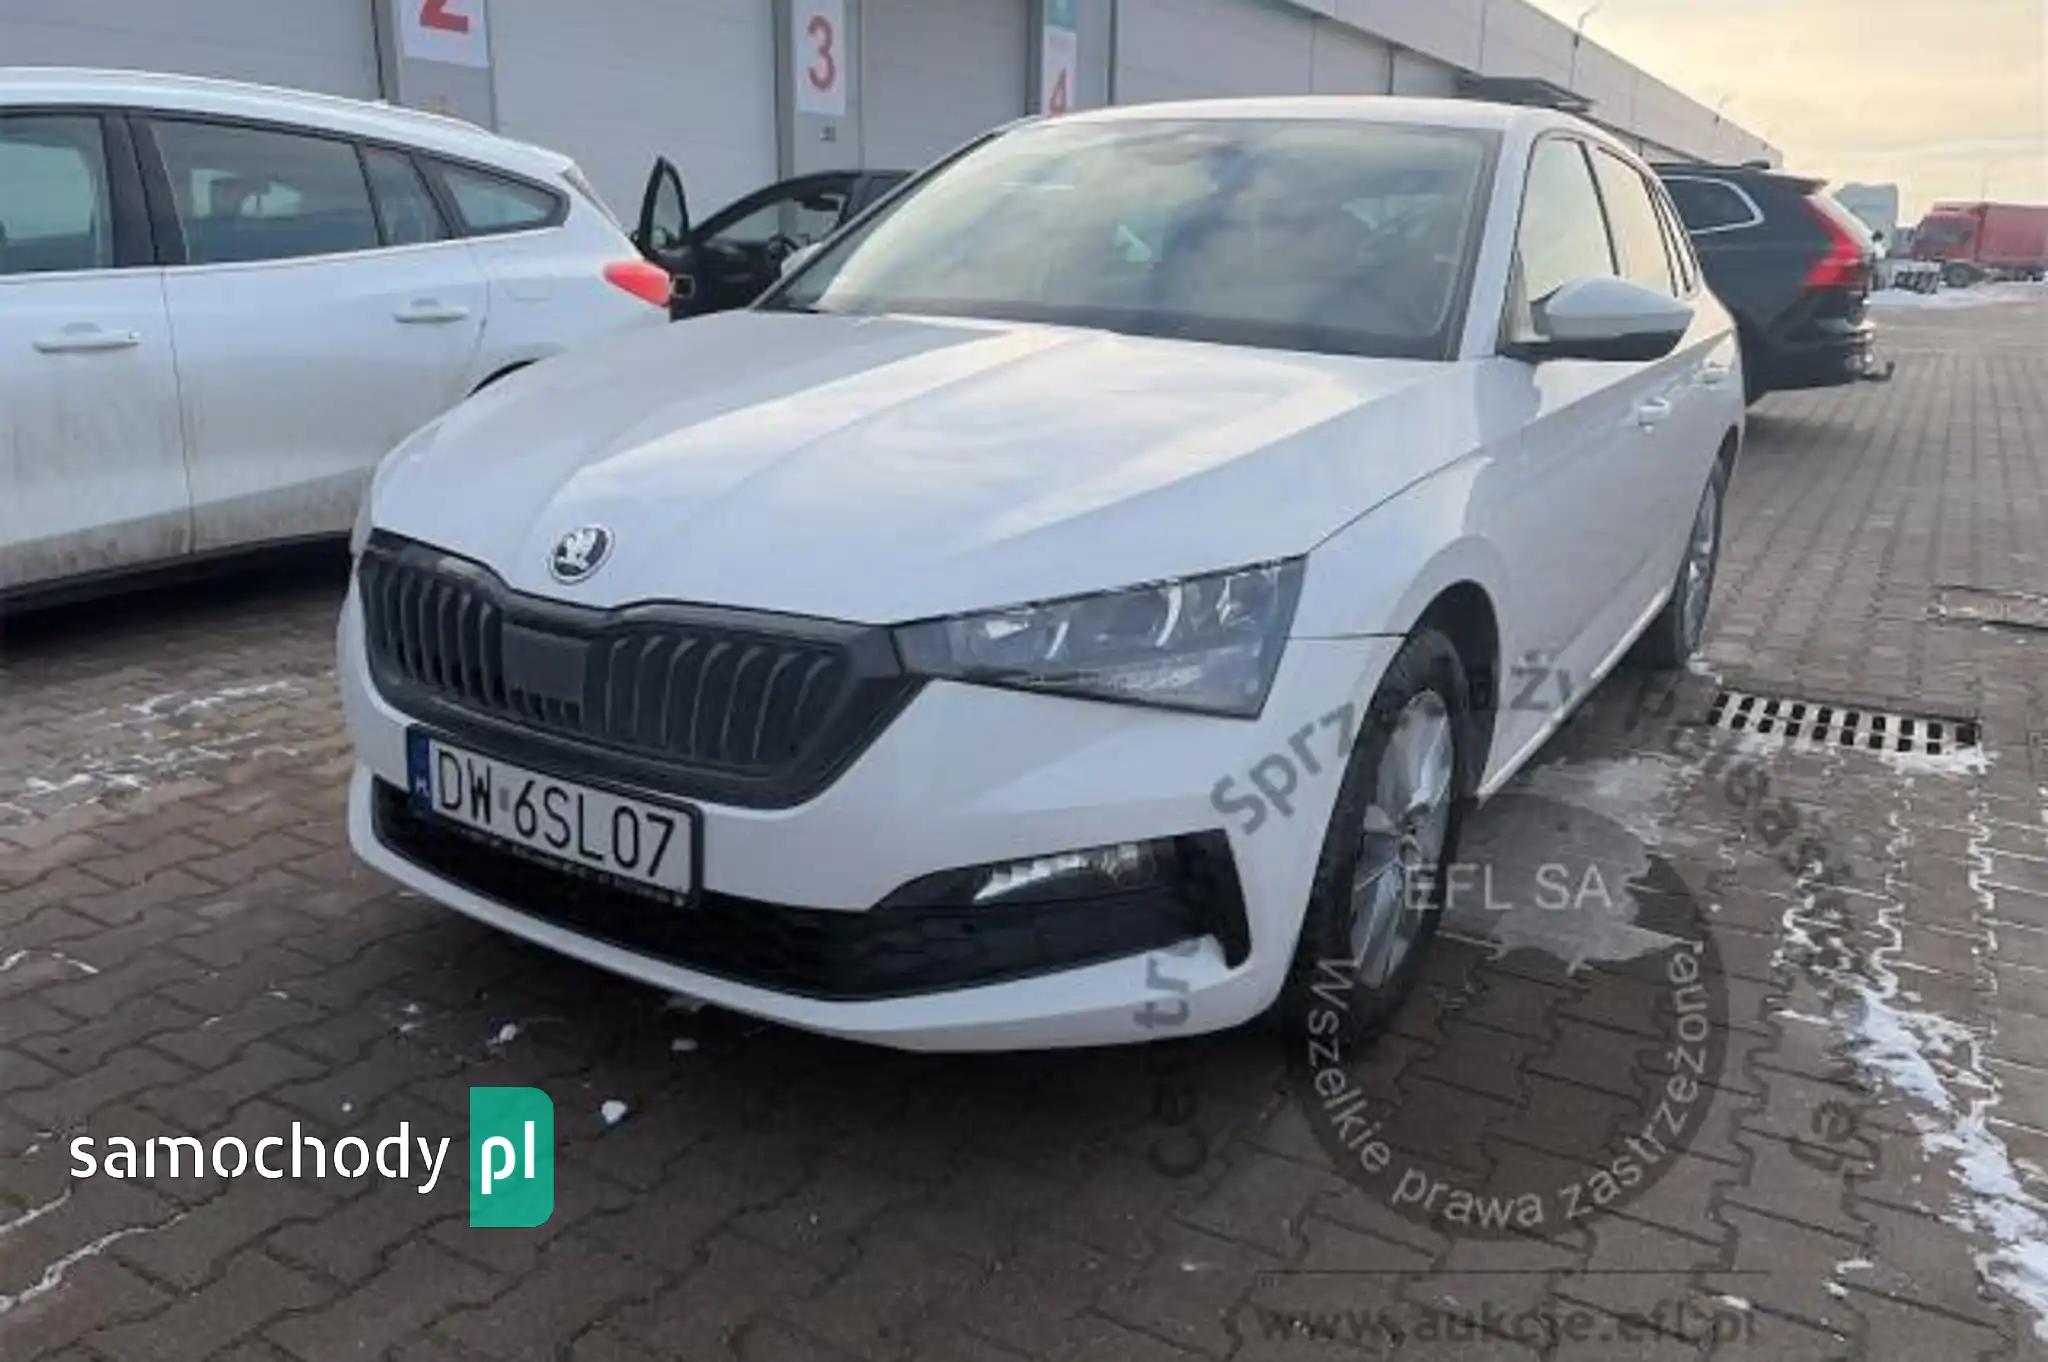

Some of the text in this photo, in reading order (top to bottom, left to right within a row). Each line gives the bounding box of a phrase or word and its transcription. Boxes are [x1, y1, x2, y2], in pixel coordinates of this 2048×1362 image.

[808, 14, 836, 91] 3
[1048, 67, 1069, 118] 4
[437, 748, 491, 825] DW
[513, 778, 676, 878] 6SL07
